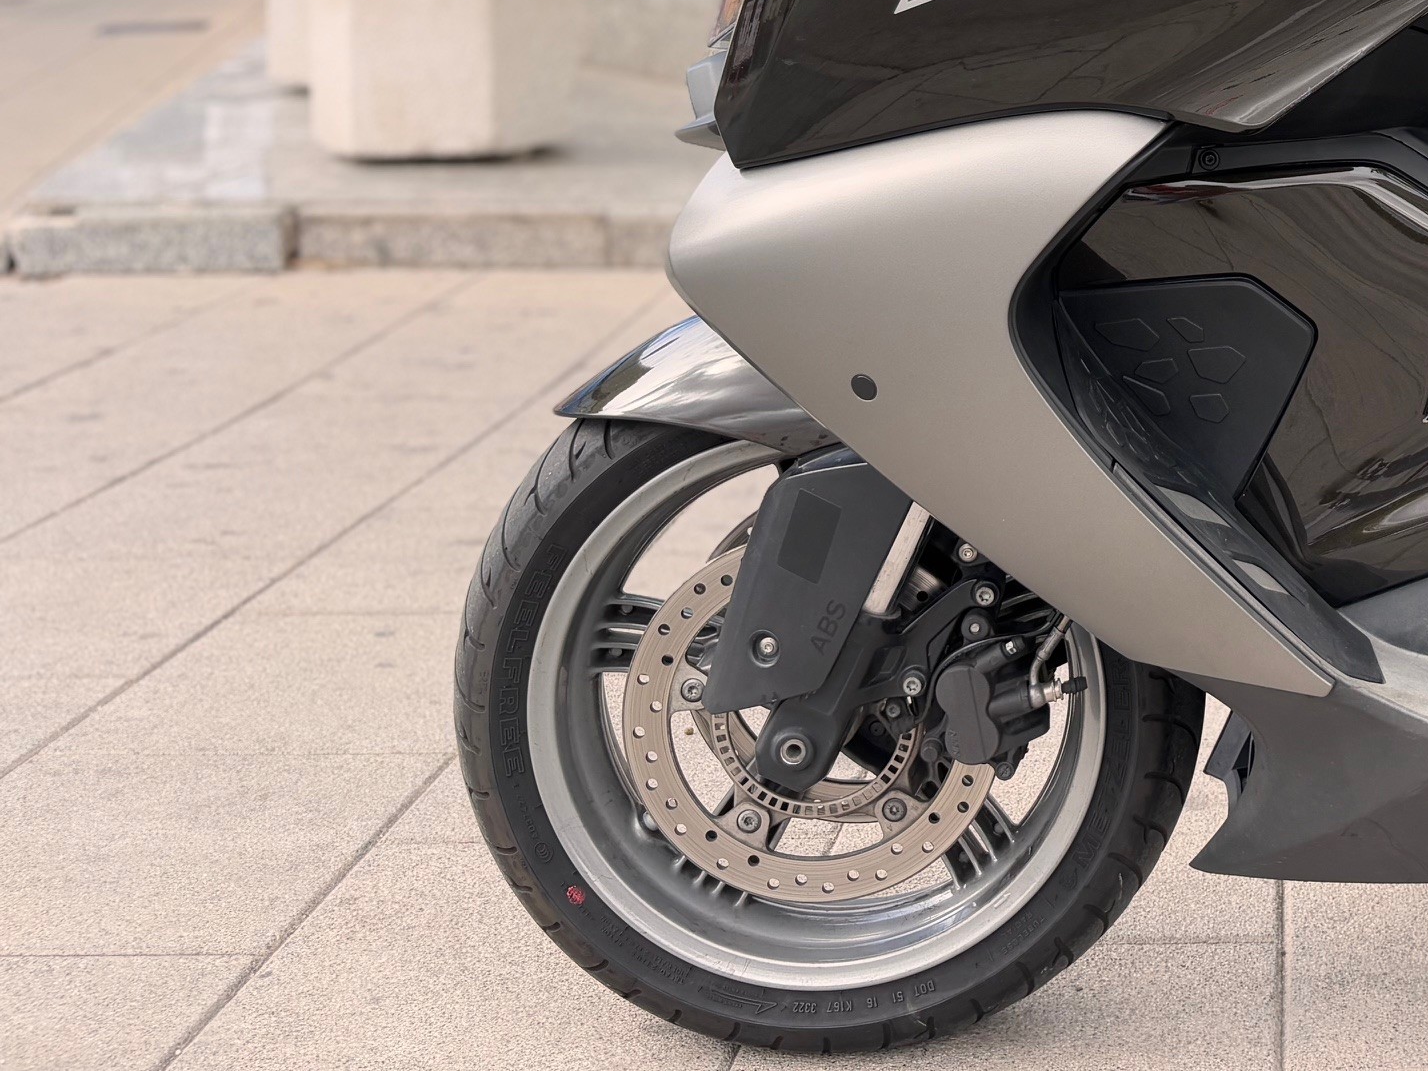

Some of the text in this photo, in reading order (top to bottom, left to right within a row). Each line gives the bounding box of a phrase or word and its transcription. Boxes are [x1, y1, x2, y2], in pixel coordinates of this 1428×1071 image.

[810, 598, 846, 656] ABS
[498, 543, 567, 777] FEELFREE
[792, 979, 935, 1014] DOT 51 16 K167 3322
